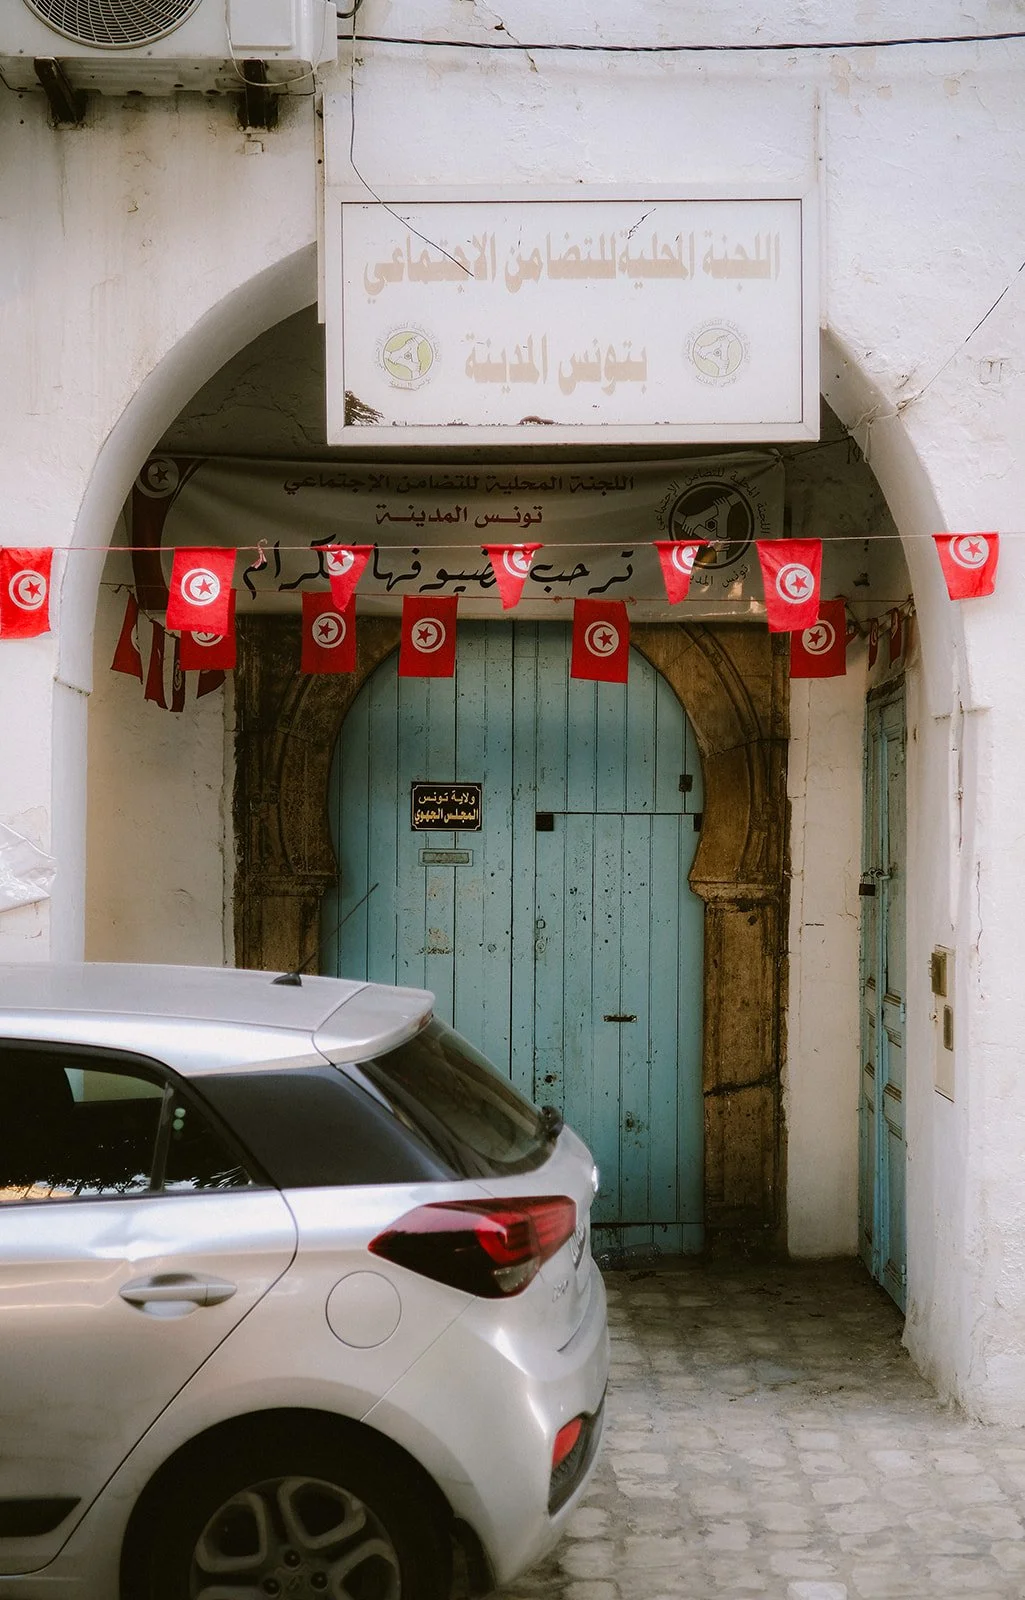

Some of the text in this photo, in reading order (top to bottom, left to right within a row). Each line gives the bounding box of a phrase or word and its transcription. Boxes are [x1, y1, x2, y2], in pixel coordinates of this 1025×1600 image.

[364, 229, 780, 304] اللجنة المحلية للتضامن الاجتماعي
[465, 332, 548, 394] المدينة
[558, 337, 647, 396] بتونس
[396, 474, 480, 493] للتضامن
[485, 474, 563, 495] المحلية
[569, 474, 634, 496] اللجنة
[375, 503, 543, 528] تونس المدينة
[242, 533, 634, 600] ترحب ضيوفها كرام
[418, 789, 476, 805] ولاية تونس
[414, 807, 479, 825] المجلس الجهوي
